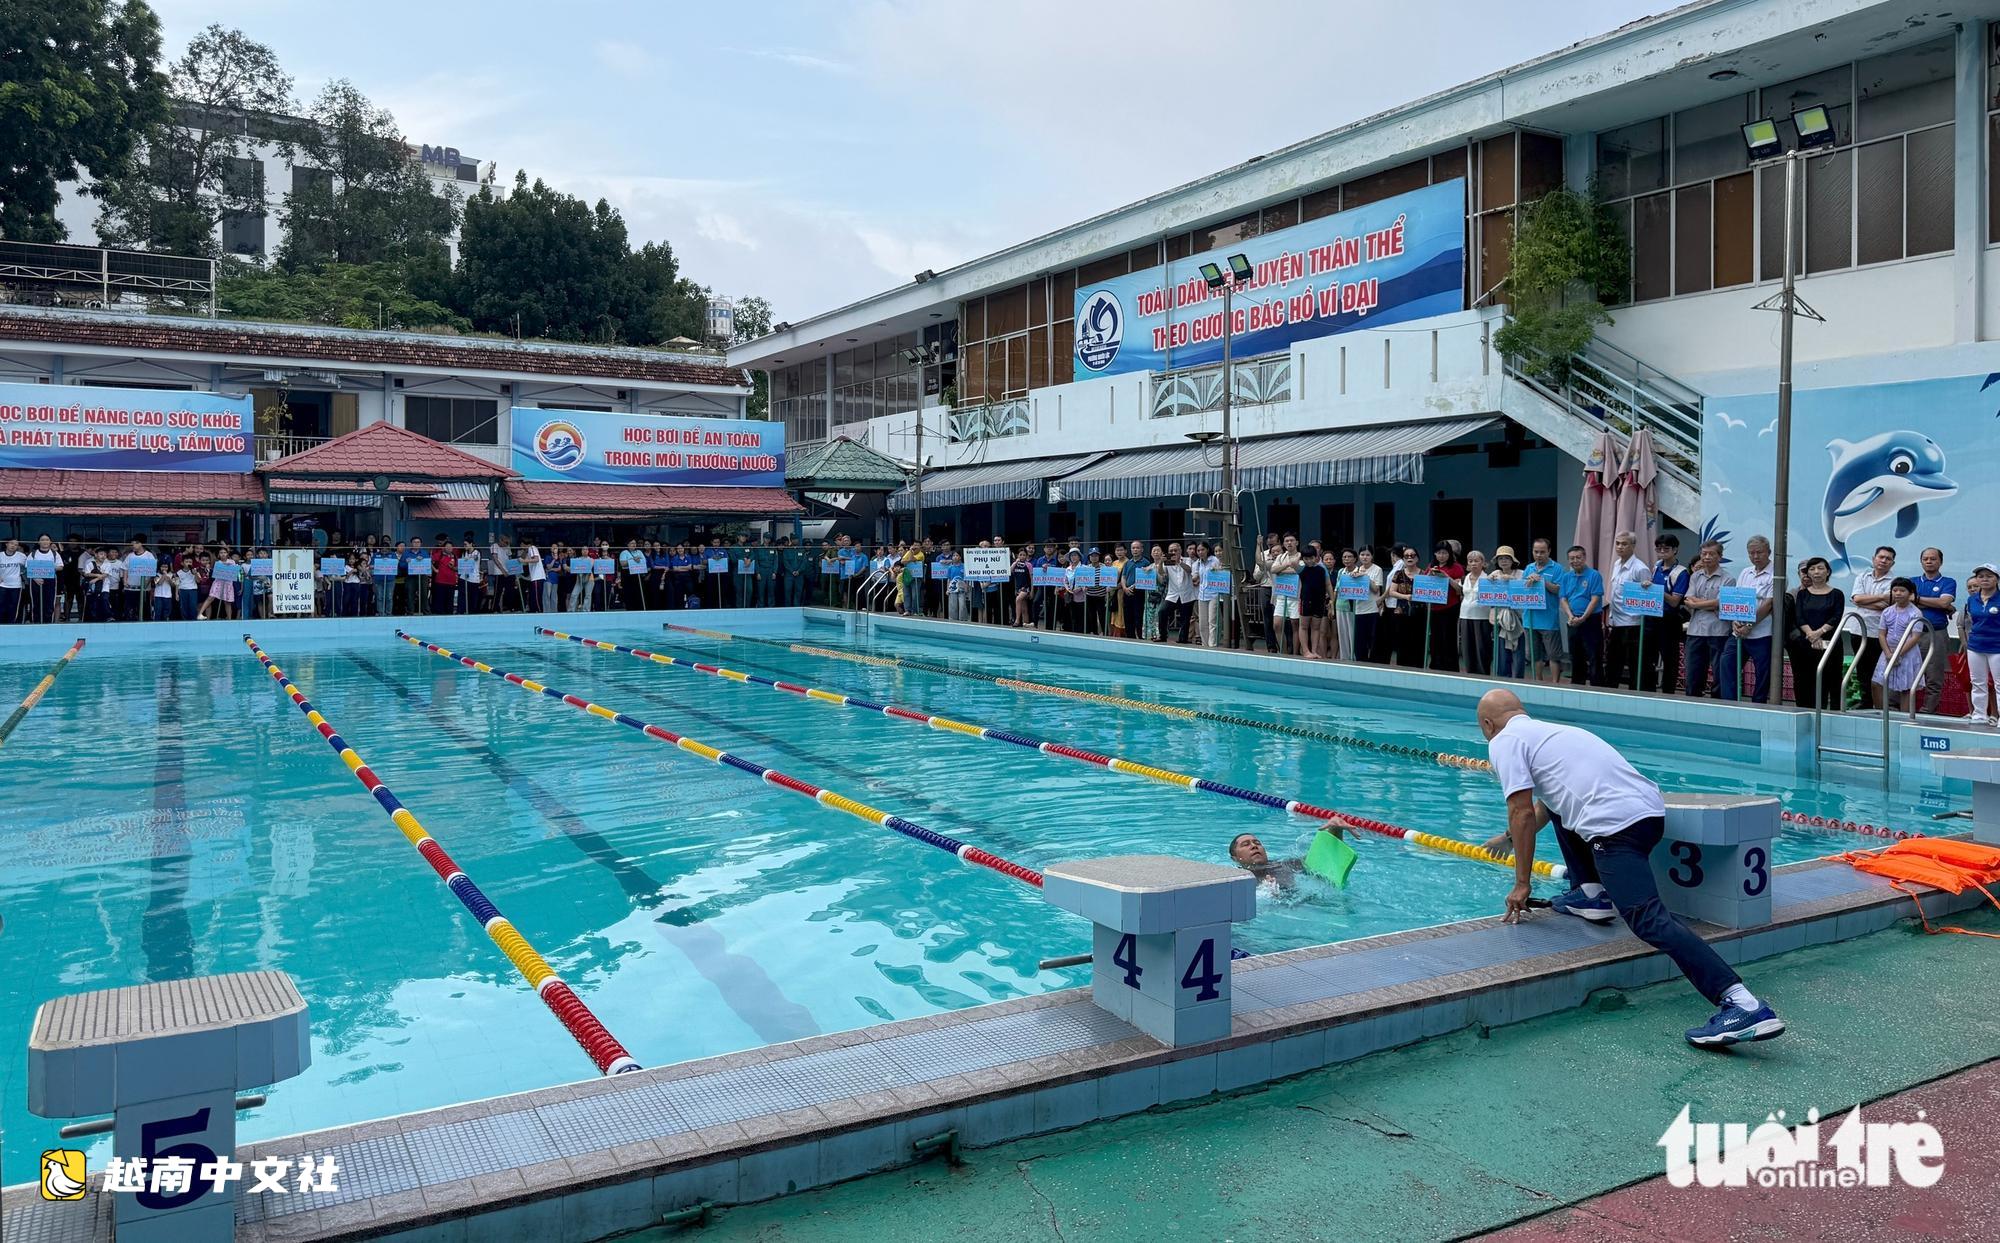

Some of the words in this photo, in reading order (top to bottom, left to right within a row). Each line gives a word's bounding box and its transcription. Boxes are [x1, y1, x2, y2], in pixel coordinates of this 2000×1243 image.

[421, 144, 461, 168] MB
[1177, 277, 1207, 307] DÂN
[1249, 252, 1303, 288] LUYỆN
[1309, 237, 1359, 274] THÂN
[1366, 214, 1406, 260] THỂ
[1153, 322, 1188, 350] THEO
[1192, 310, 1245, 342] GƯƠG
[1250, 298, 1284, 330] BÁC
[1290, 286, 1314, 322] HỒ
[1319, 282, 1338, 315] VĨ
[1342, 279, 1377, 313] ĐẠI
[0, 405, 21, 423] ỌC
[27, 406, 54, 421] BƠI
[59, 403, 80, 422] ĐỂ
[84, 407, 129, 424] NÂNG
[133, 411, 163, 426] CAO
[168, 411, 198, 427] SỨC
[203, 409, 241, 428] KHỎE
[12, 428, 53, 445] PHÁT
[58, 427, 104, 447] TRIỂN
[109, 429, 137, 448] THỂ
[179, 431, 211, 450] TẦM
[216, 434, 245, 452] VÓC
[624, 428, 652, 445] HỌC
[656, 429, 679, 443] BƠI
[683, 425, 700, 445] ĐỂ
[704, 432, 722, 445] AN
[726, 430, 760, 447] TOÀN
[605, 451, 651, 466] TRONG
[656, 450, 682, 467] MÔI
[686, 452, 738, 469] TRƯỜNG
[741, 453, 777, 470] NƯỚC
[1625, 598, 1639, 606] KHU
[1721, 603, 1735, 612] KHU
[1923, 738, 1947, 750] 1m8
[1668, 840, 1704, 888] 3
[1743, 846, 1768, 896] 3
[1113, 933, 1143, 990] 4
[1180, 938, 1223, 1002] 4
[134, 1106, 219, 1210] 5
